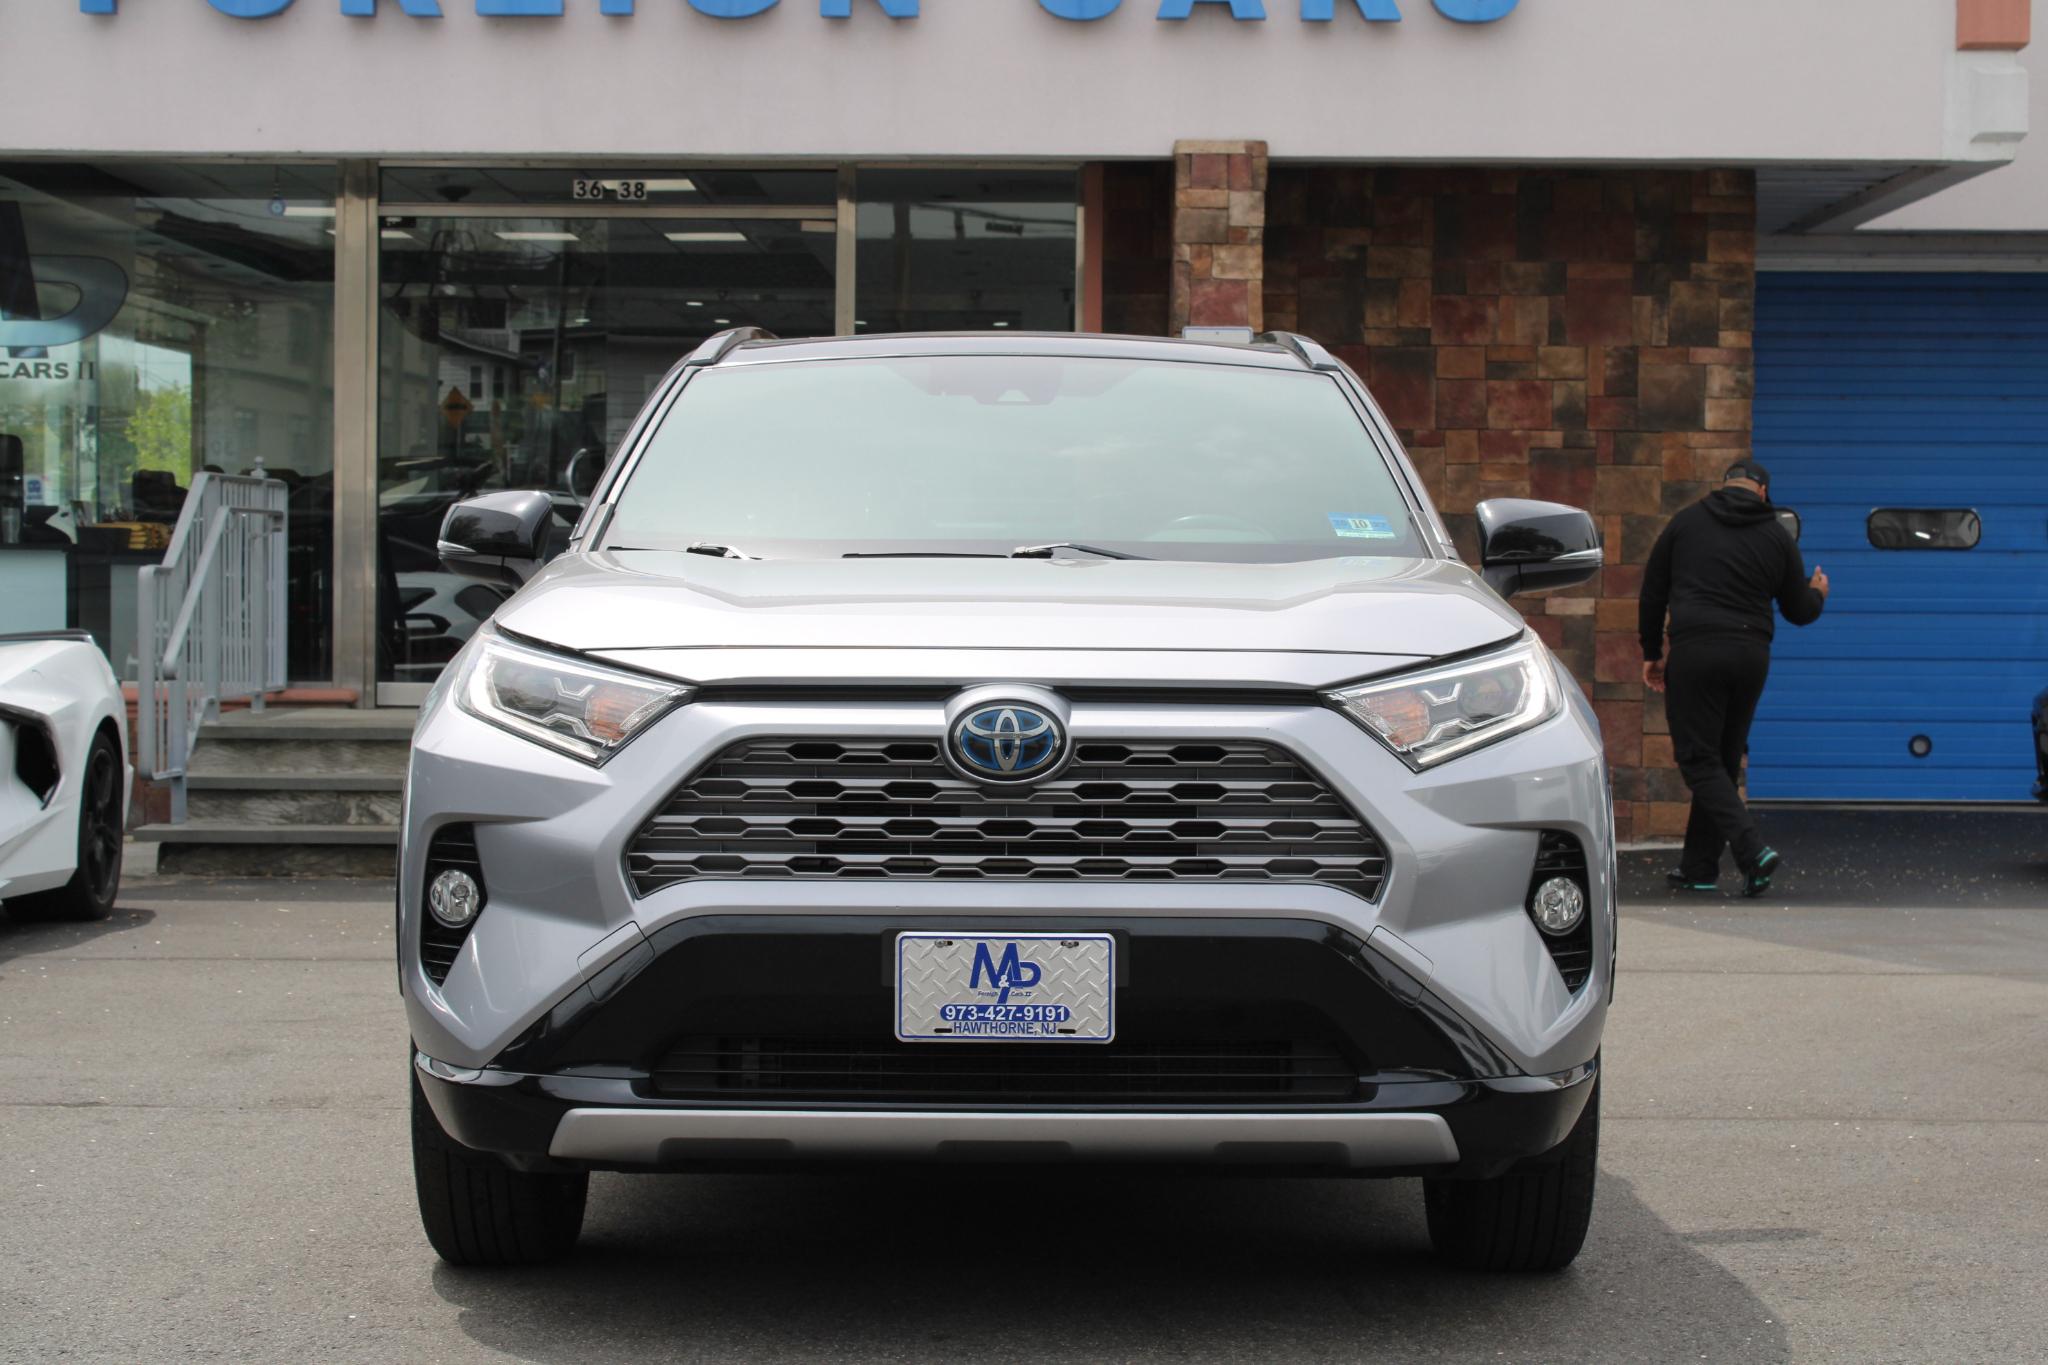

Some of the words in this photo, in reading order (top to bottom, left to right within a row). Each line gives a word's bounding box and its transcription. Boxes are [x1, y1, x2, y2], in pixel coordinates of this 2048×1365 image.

[945, 1005, 1066, 1021] 973-427-9191
[953, 1021, 1037, 1035] HAWTHORNE,
[1041, 1022, 1057, 1034] NJ
